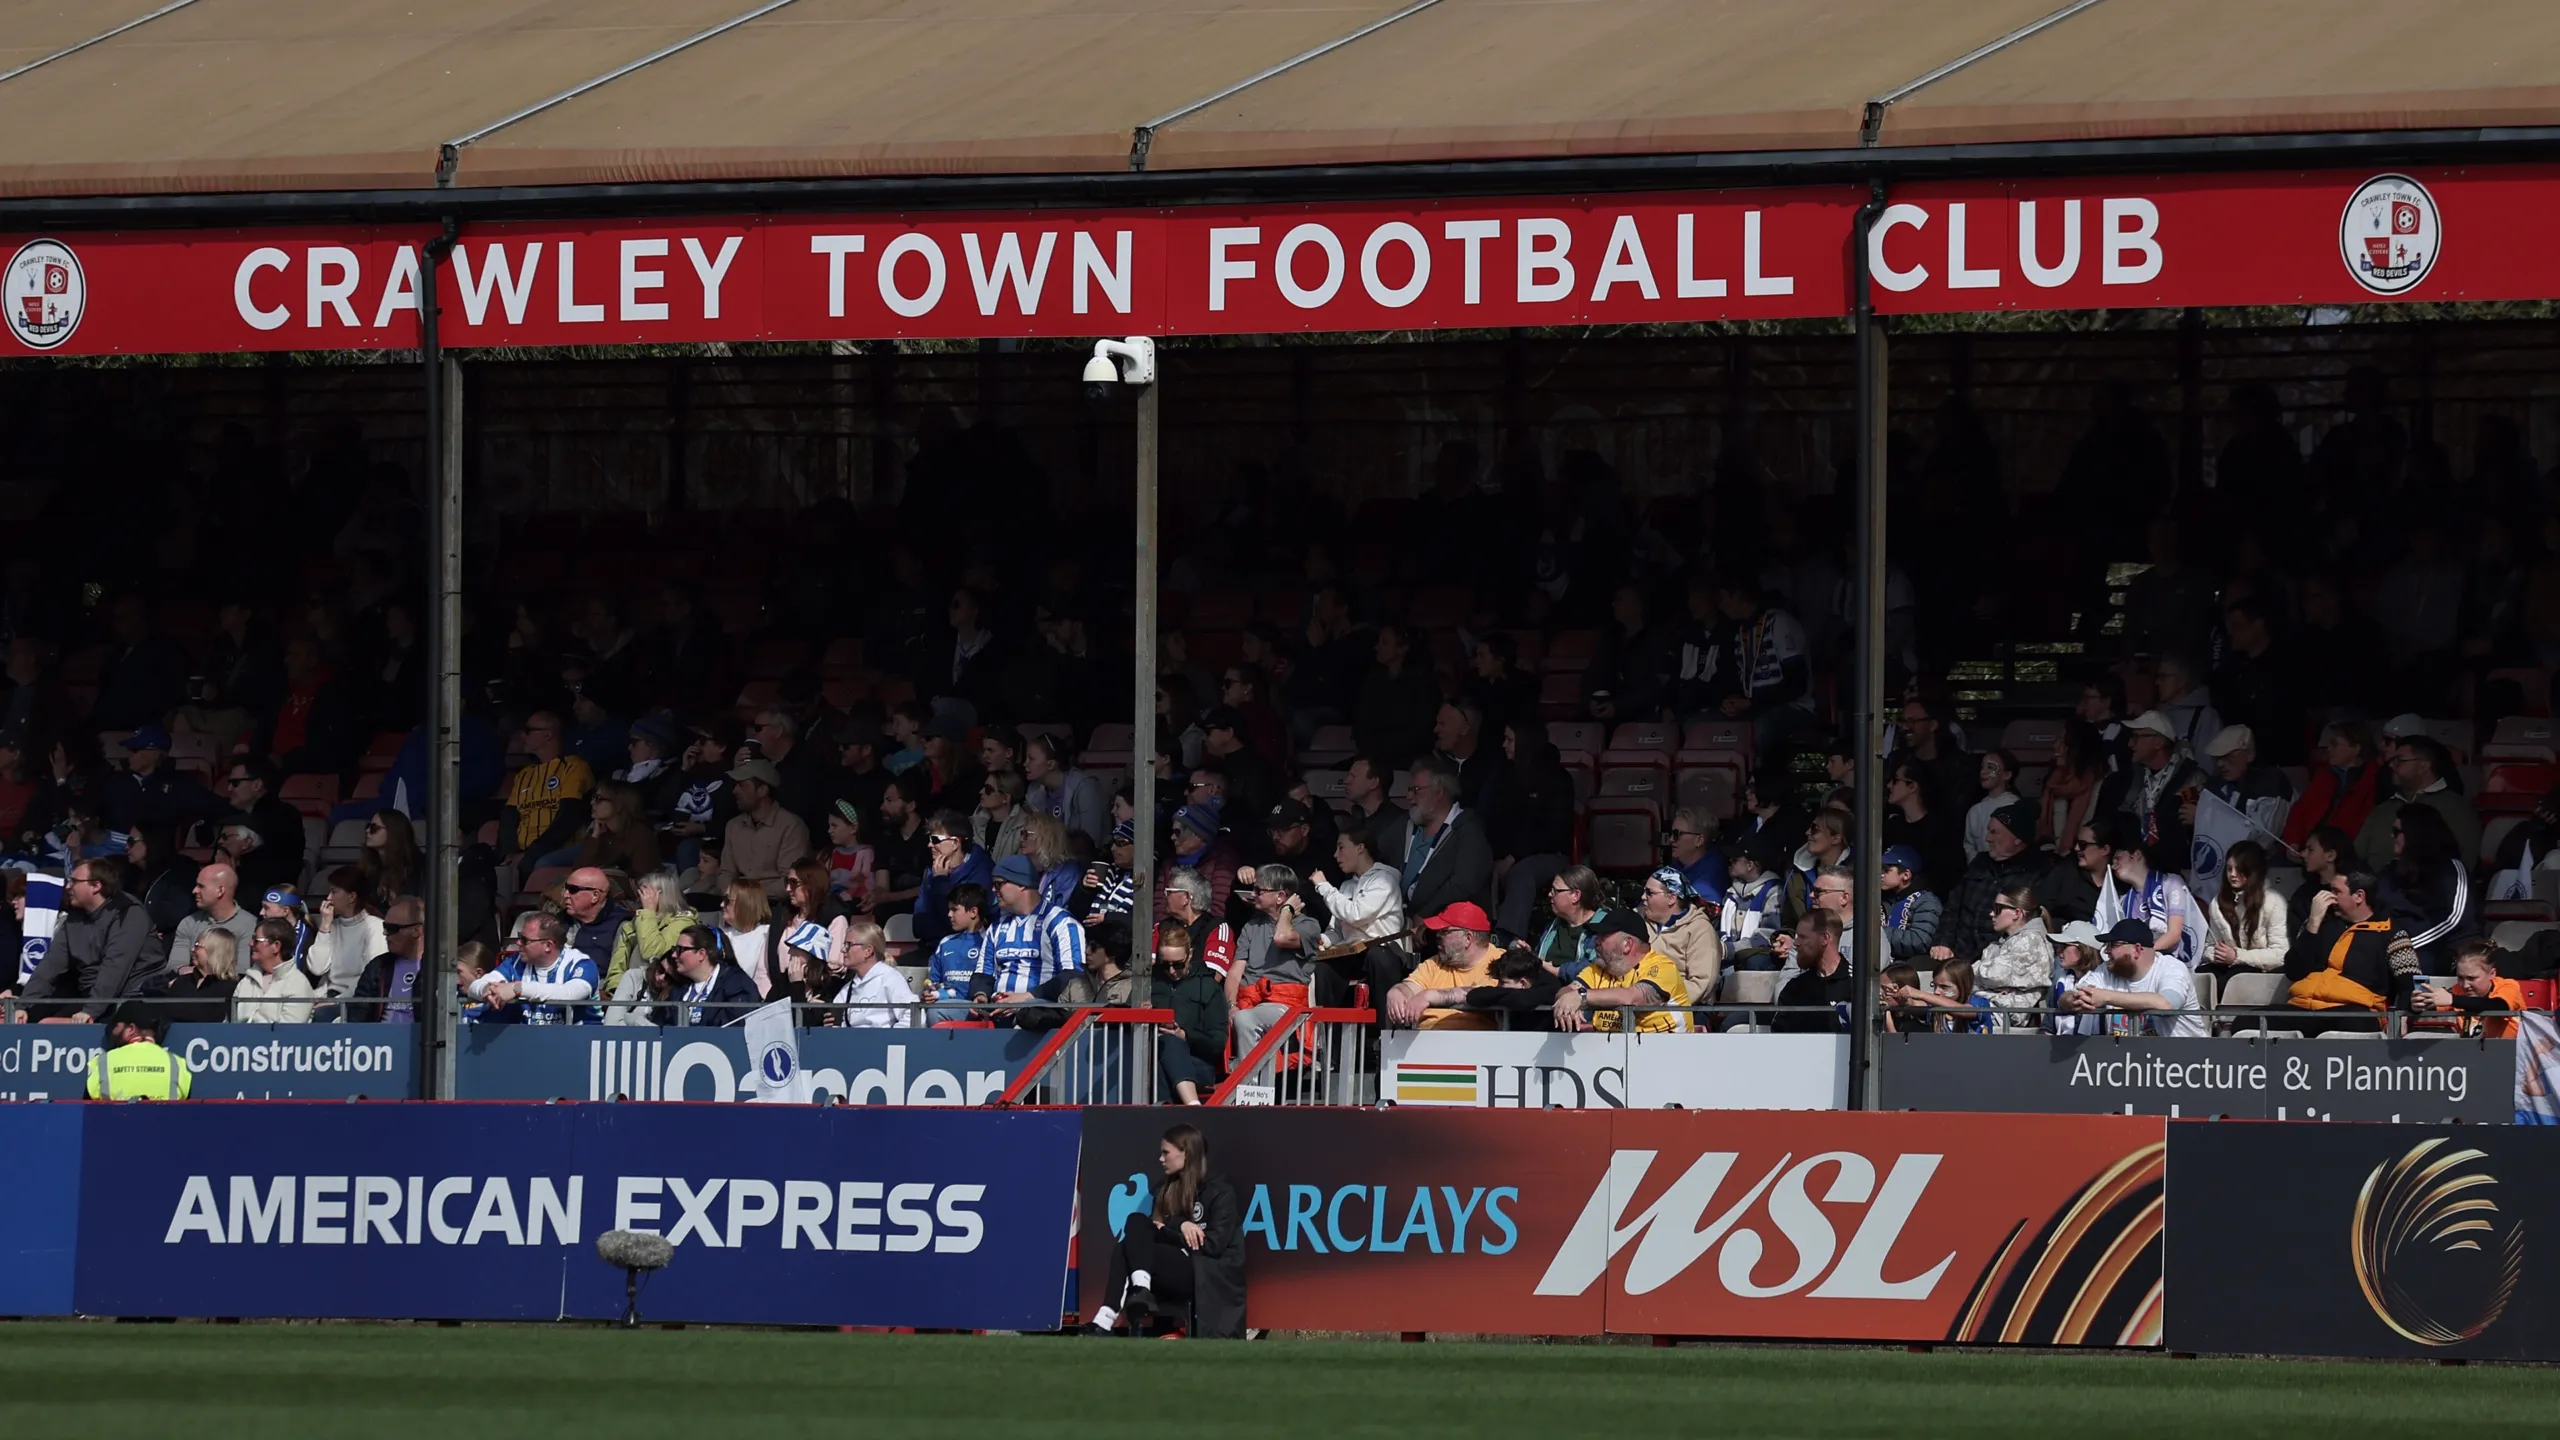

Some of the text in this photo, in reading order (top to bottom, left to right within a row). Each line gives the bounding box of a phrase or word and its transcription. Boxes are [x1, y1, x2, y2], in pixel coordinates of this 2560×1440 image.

[2361, 193, 2421, 207] CRAWLEY TOWN FC
[19, 256, 45, 269] CRAWLEY
[46, 256, 62, 264] TOWN
[235, 198, 2162, 330] CRAWLEY TOWN FOOTBALL CLUB
[2373, 267, 2408, 278] RED DEVILS
[29, 324, 58, 334] RED DEVILS
[113, 1066, 135, 1074] SAFETY
[185, 1036, 393, 1073] Construction
[1243, 1090, 1256, 1098] Seat
[2070, 1052, 2466, 1102] Architecture & Planning
[164, 1176, 583, 1245] AMERICAN
[615, 1176, 986, 1253] EXPRESS
[1242, 1184, 1517, 1254] ARCLAYS
[1533, 1150, 1956, 1300] WSL
